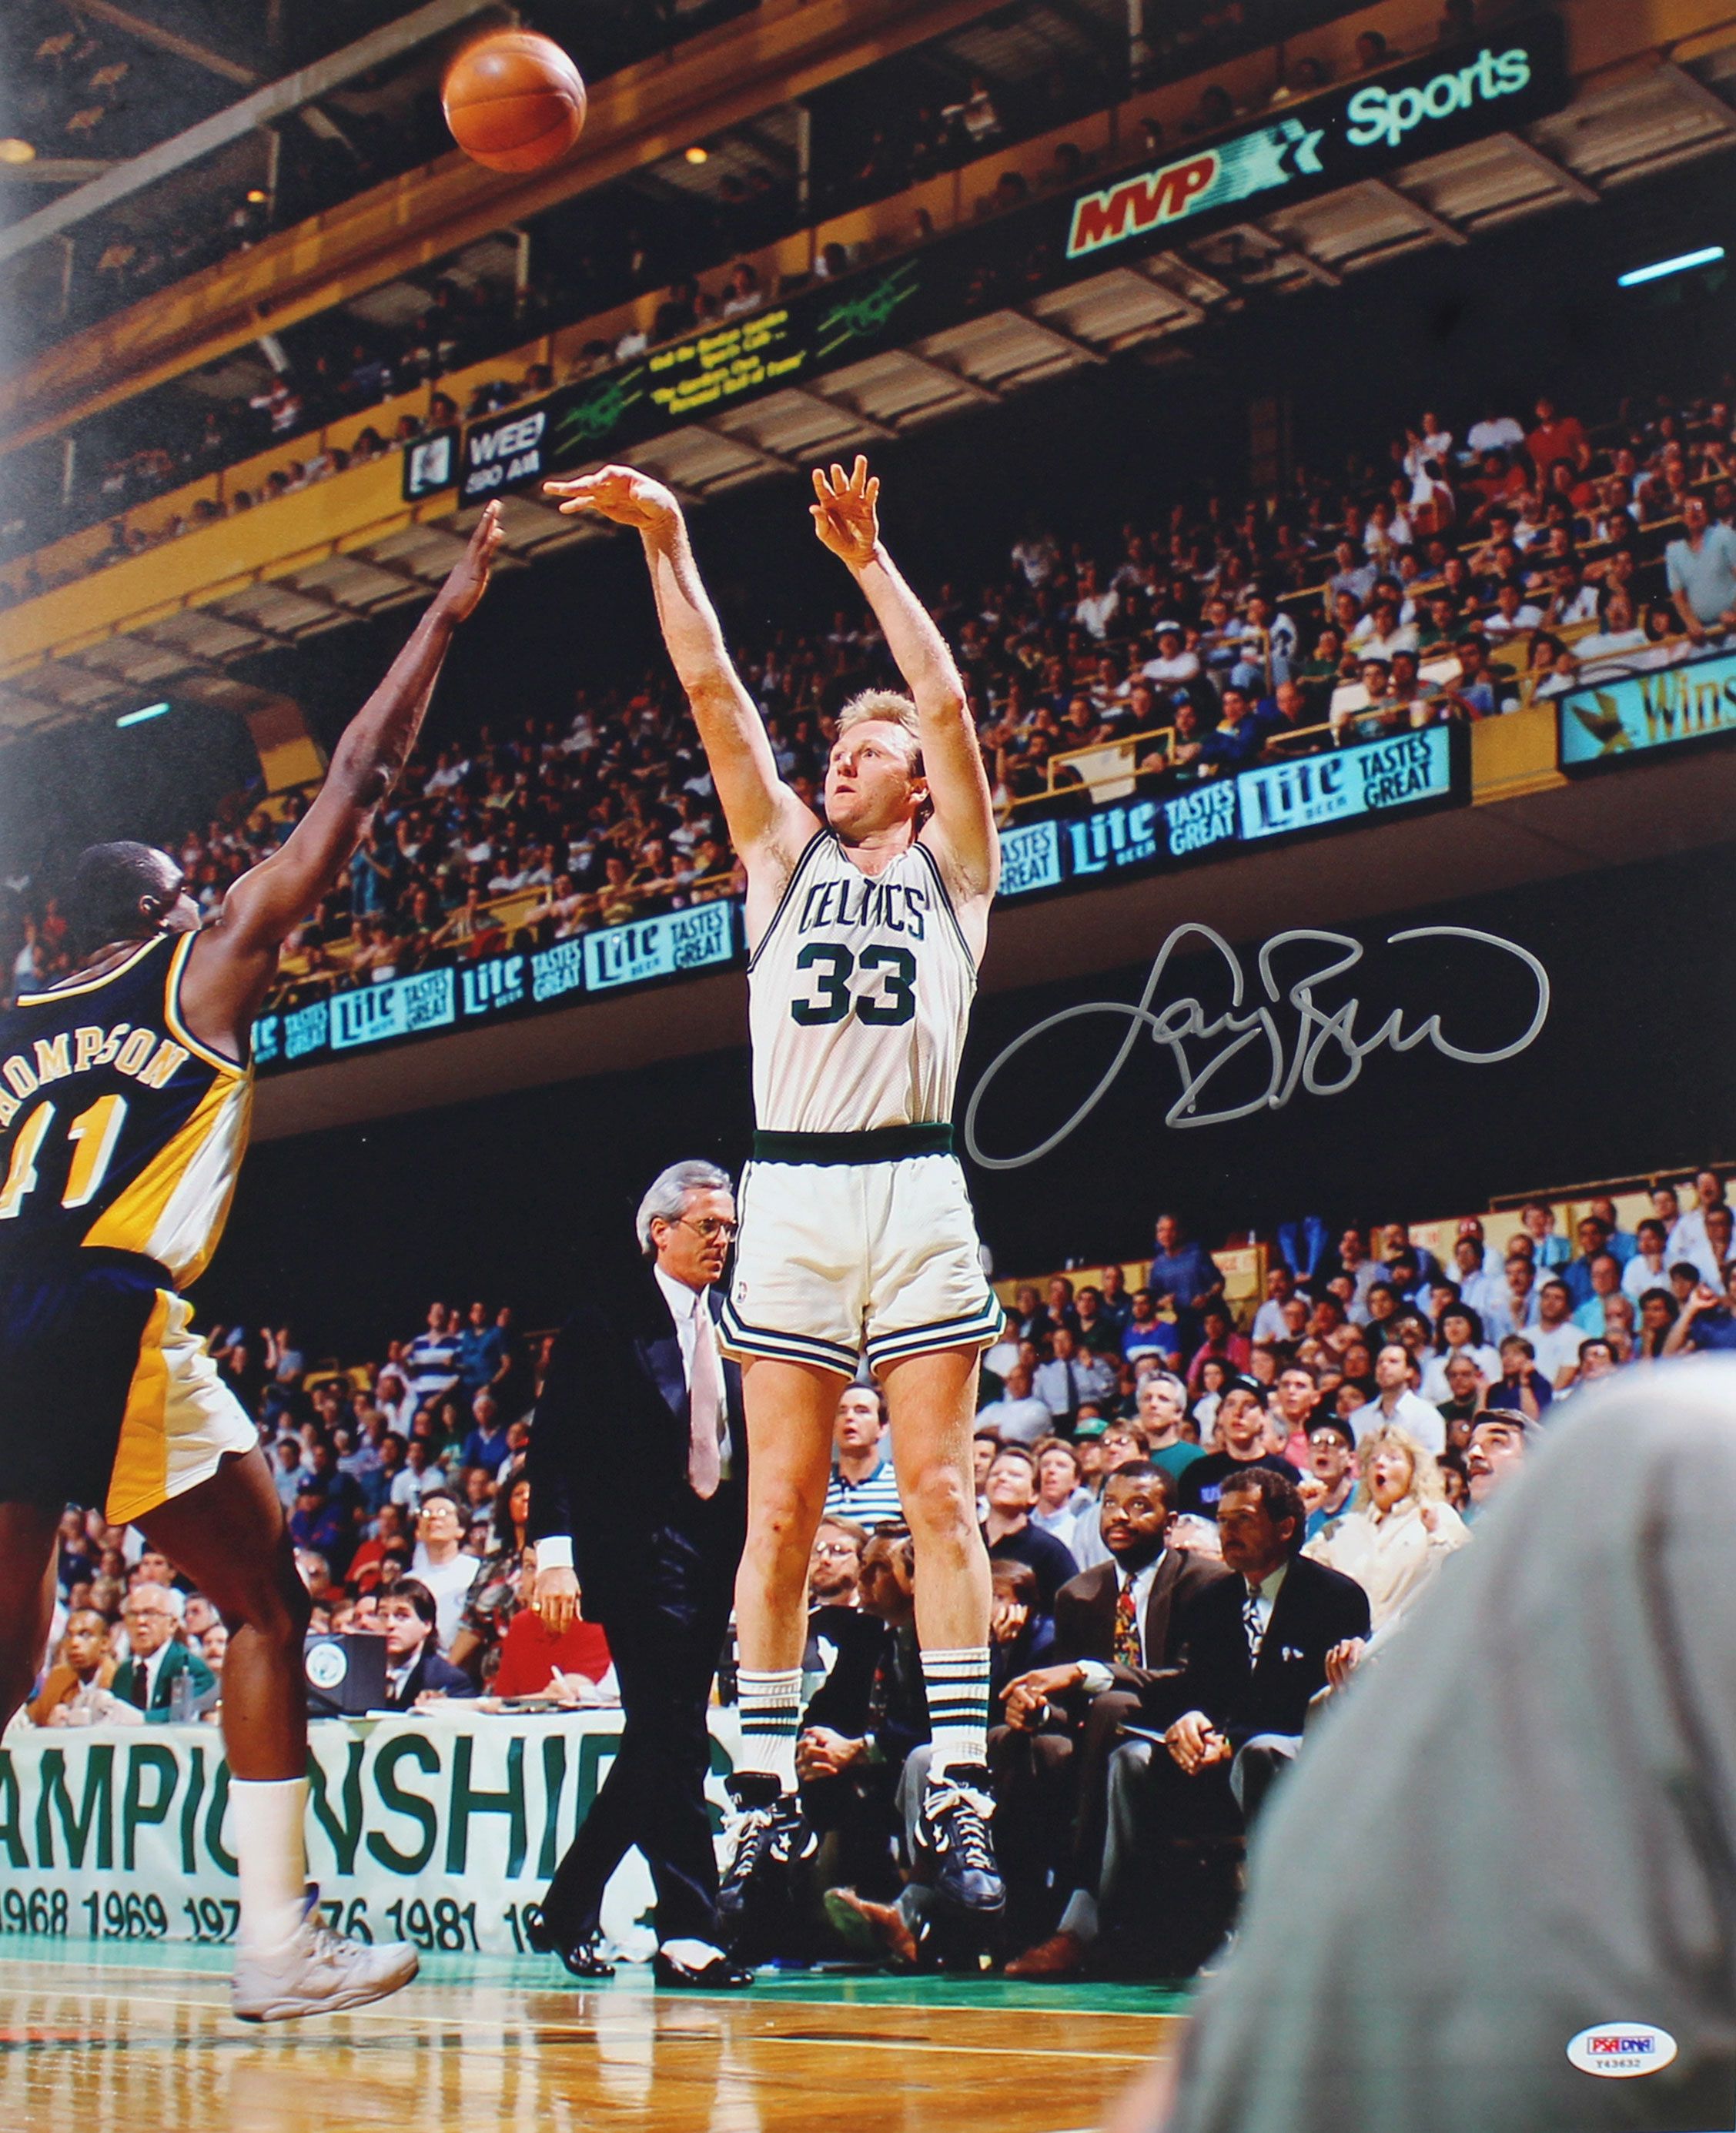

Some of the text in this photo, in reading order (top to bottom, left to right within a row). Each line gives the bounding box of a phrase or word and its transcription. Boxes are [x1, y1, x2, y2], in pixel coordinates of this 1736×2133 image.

[1066, 48, 1530, 259] MVP Sports
[1358, 731, 1432, 781] TASTES
[1164, 779, 1235, 828] TASTES
[1255, 757, 1343, 828] Lite
[1363, 761, 1432, 809] GREAT
[1001, 825, 1051, 864] ASTES
[1068, 802, 1156, 875] Lite
[1169, 810, 1234, 856] GREAT
[669, 908, 724, 943] TASTES
[798, 878, 931, 941] CELTICS
[530, 938, 582, 977] TASTES
[595, 924, 658, 983] Lite
[671, 931, 723, 969] GREAT
[462, 954, 524, 1015] Lite
[532, 961, 580, 1002] GREAT
[791, 942, 917, 1027] 33
[340, 988, 395, 1041] Lite
[0, 1022, 190, 1133] HOMPSON
[0, 1094, 128, 1220] 11
[0, 1887, 69, 1935] 968
[82, 1890, 169, 1941] 1969
[183, 1897, 241, 1944] 197
[319, 1897, 373, 1945] 76
[386, 1897, 481, 1951] 1981
